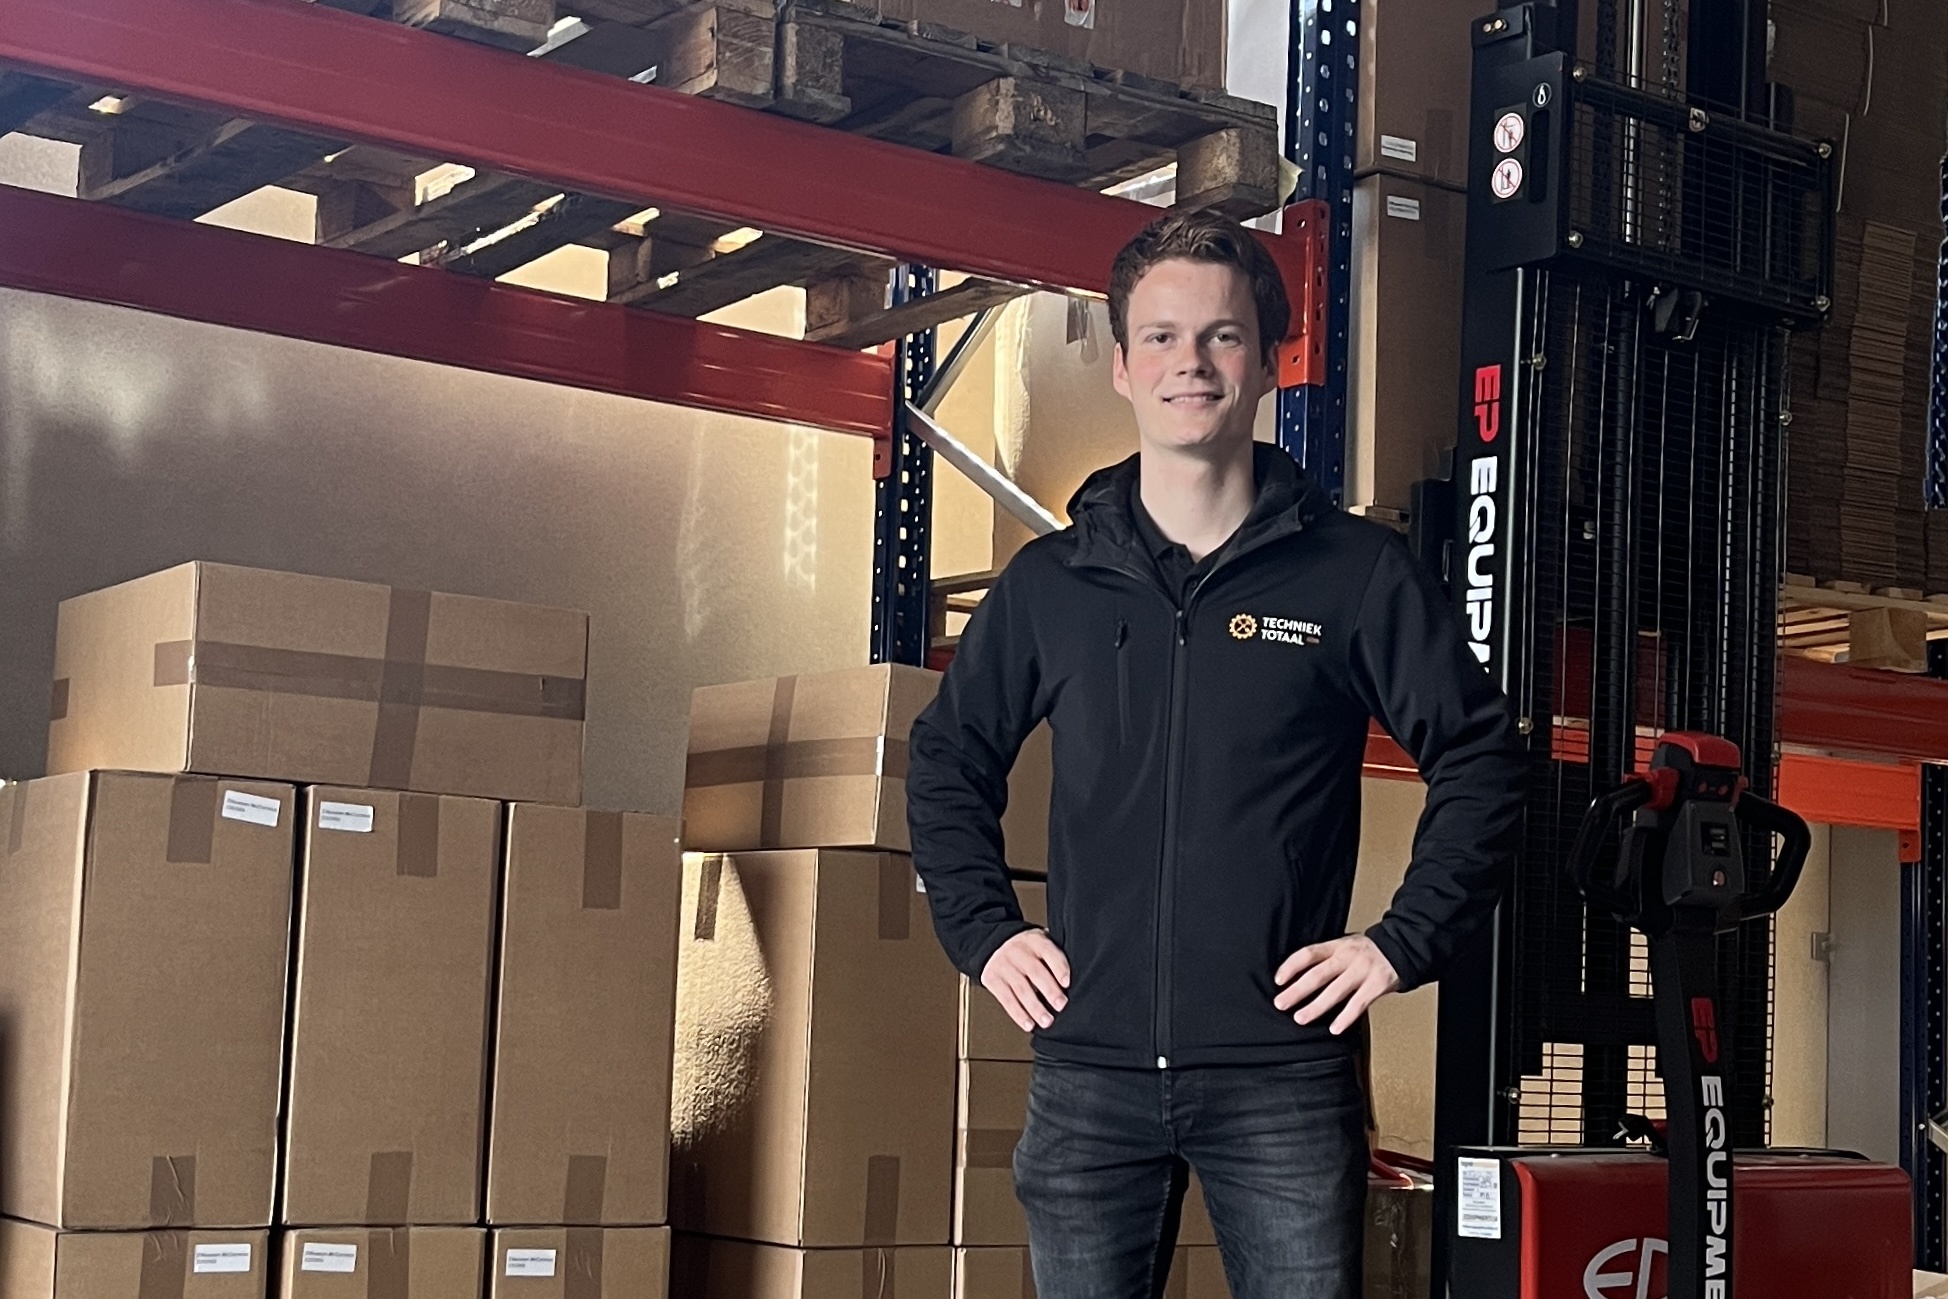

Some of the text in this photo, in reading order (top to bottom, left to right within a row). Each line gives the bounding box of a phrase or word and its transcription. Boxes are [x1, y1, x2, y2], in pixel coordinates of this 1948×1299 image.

[1474, 364, 1501, 442] EP
[1262, 616, 1322, 636] TECHNIEK
[1261, 628, 1305, 646] TOTAAL
